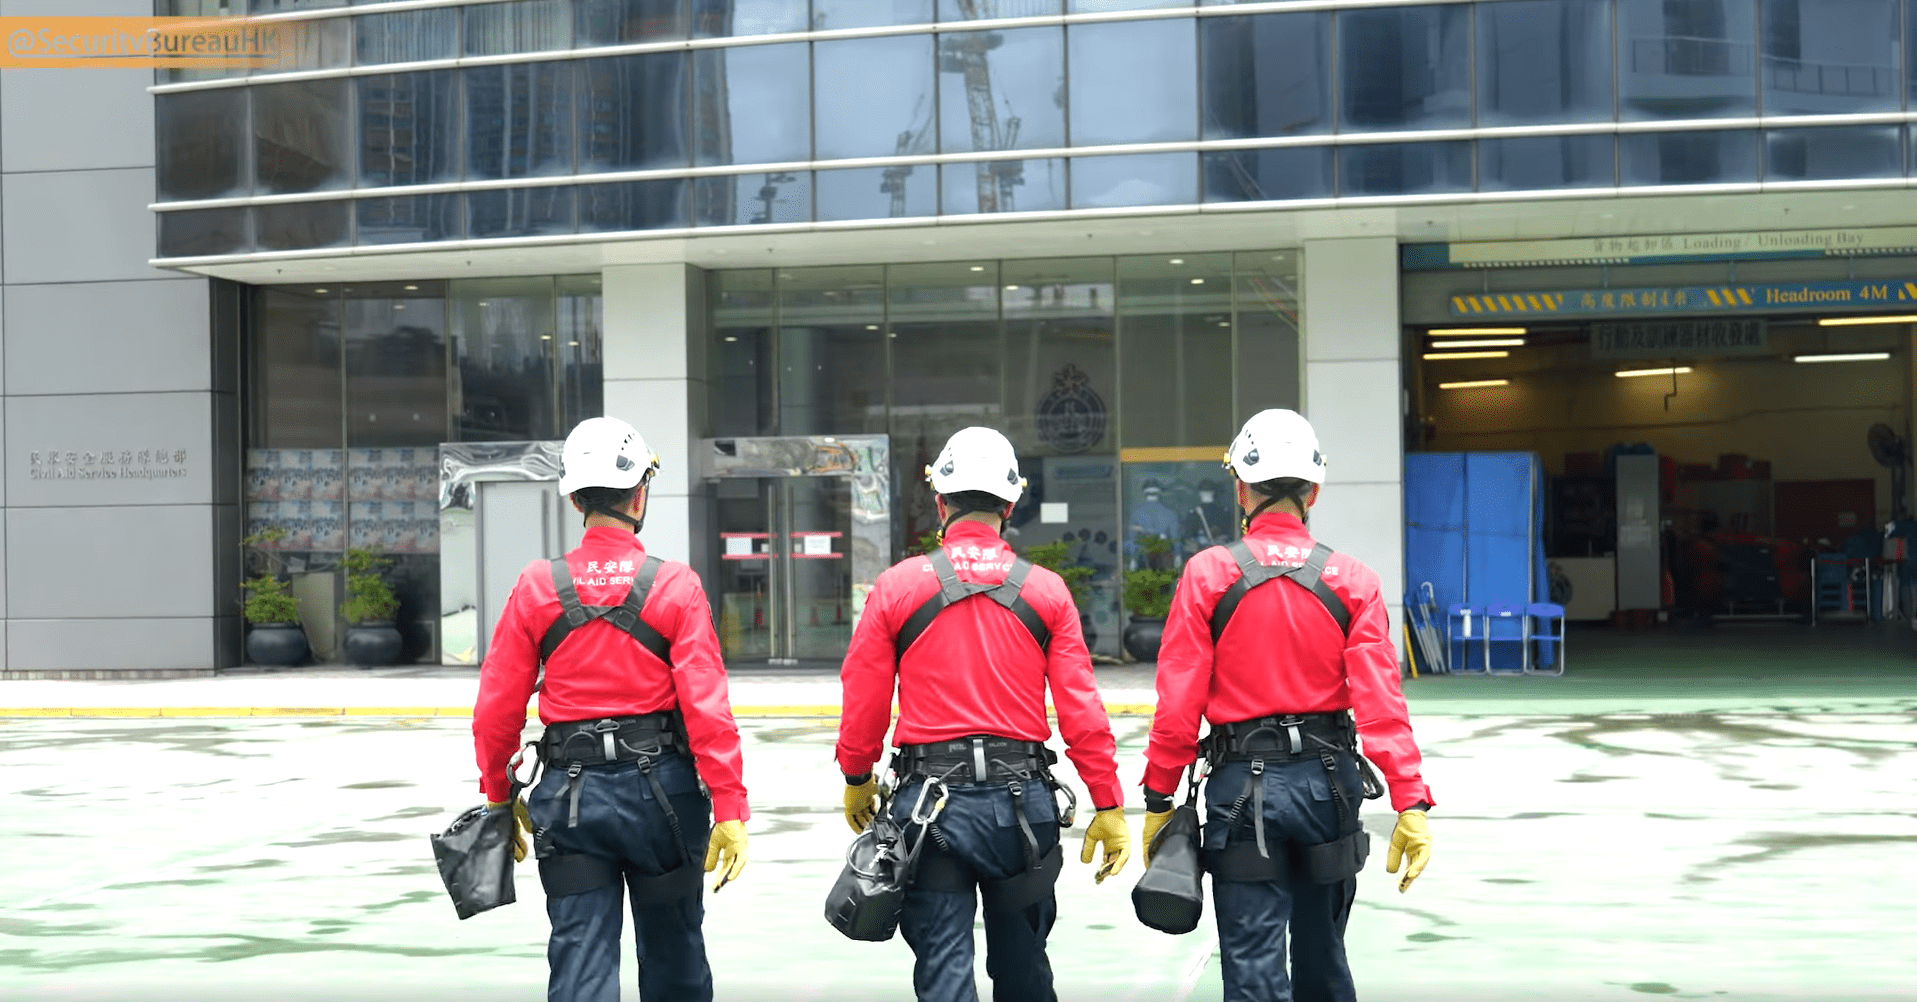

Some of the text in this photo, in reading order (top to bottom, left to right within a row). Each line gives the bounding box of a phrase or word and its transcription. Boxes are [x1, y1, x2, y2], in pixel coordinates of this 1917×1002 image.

[1758, 232, 1832, 247] Unloading
[1837, 232, 1863, 247] Bay
[1766, 284, 1888, 304] Headroom 4M
[30, 467, 187, 480] Civil Aid Service Headquarters
[587, 560, 635, 573] 民安隊
[588, 577, 606, 586] AID
